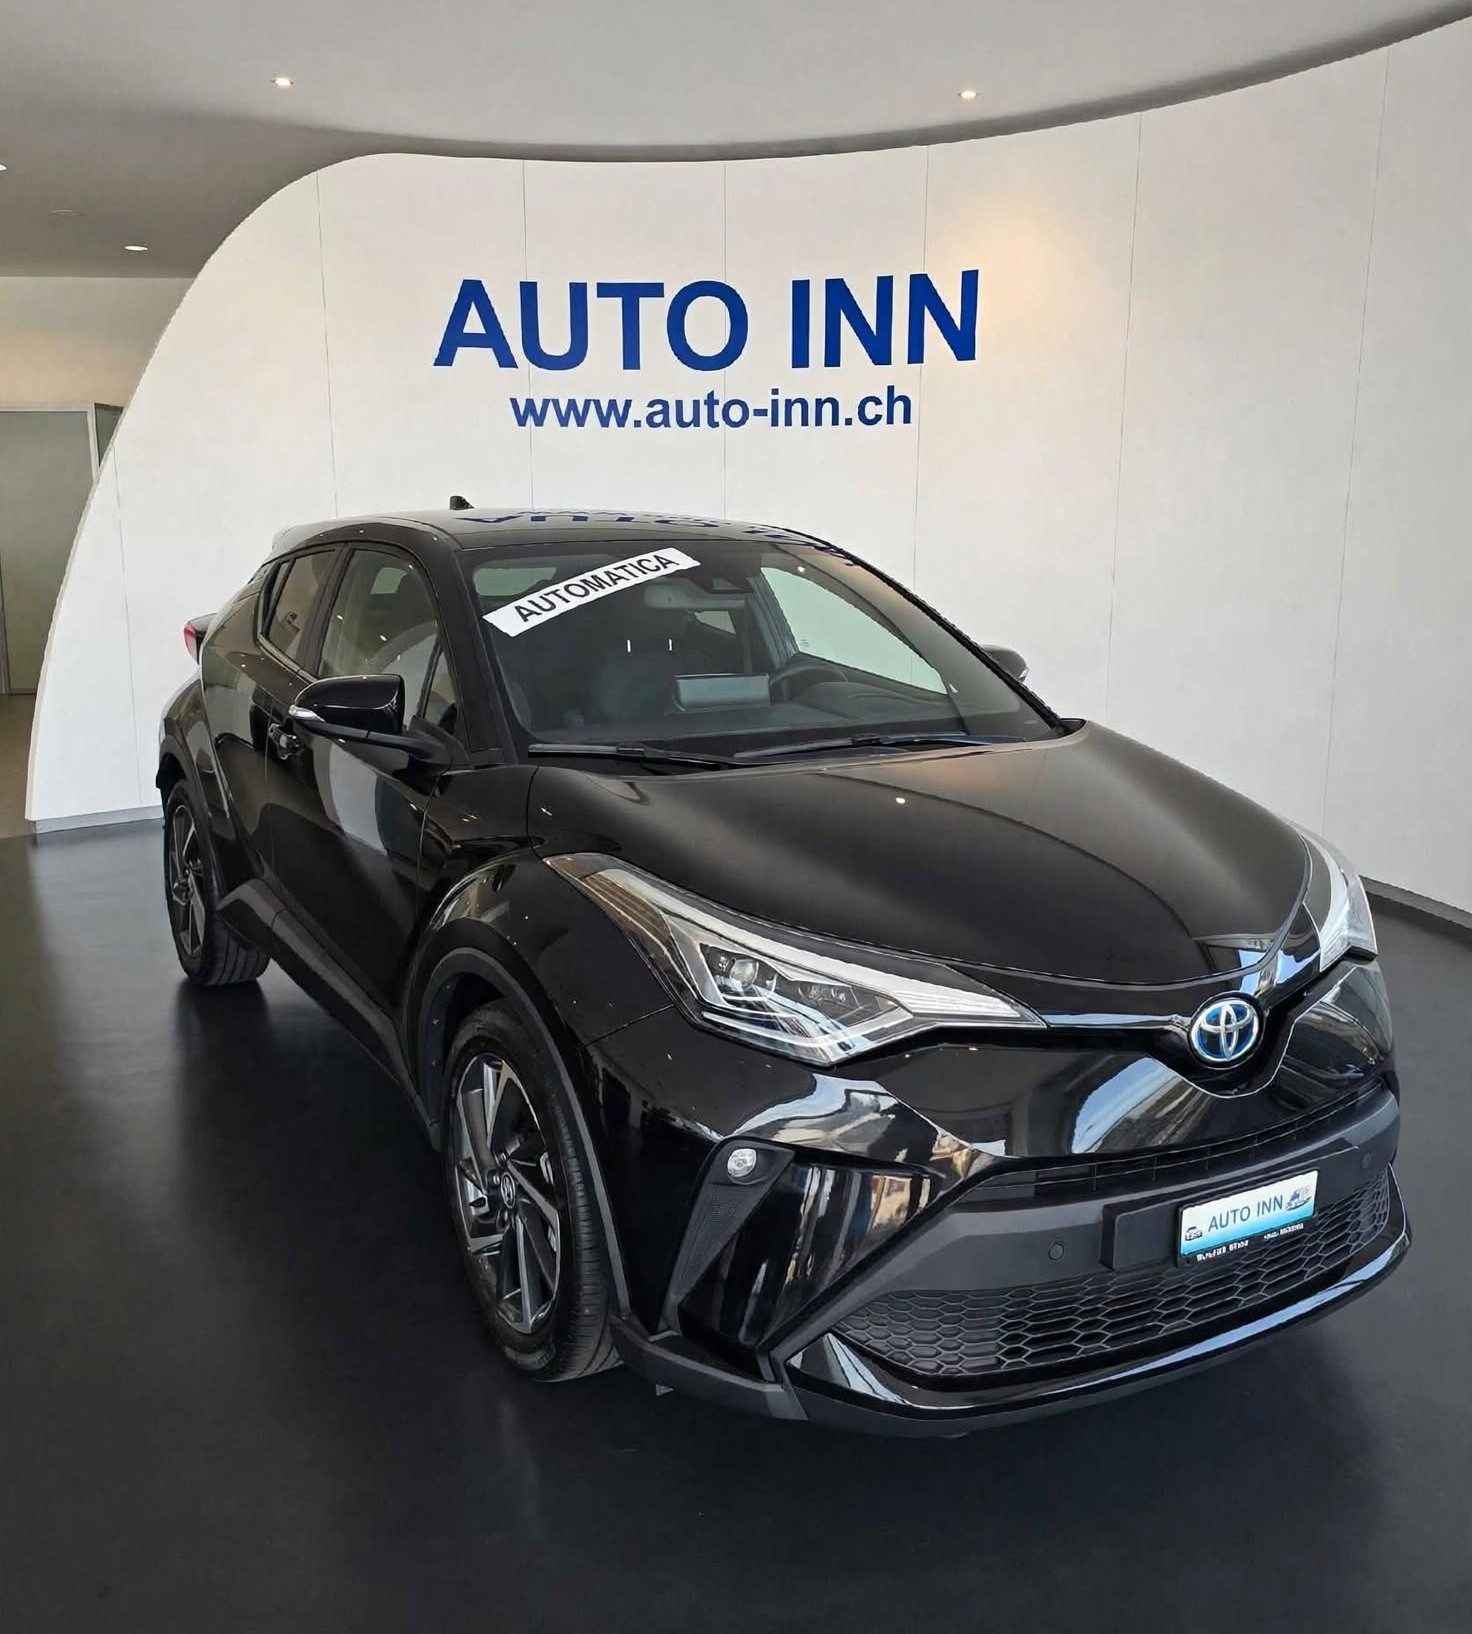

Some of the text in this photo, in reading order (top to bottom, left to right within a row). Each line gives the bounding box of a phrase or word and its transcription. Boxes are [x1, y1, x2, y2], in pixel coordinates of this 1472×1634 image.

[434, 270, 979, 372] AUTO INN
[510, 386, 913, 428] www.auto-inn.ch
[513, 554, 680, 623] AUTOMATICA
[1207, 1205, 1251, 1233] AUTO
[1256, 1194, 1284, 1217] INN
